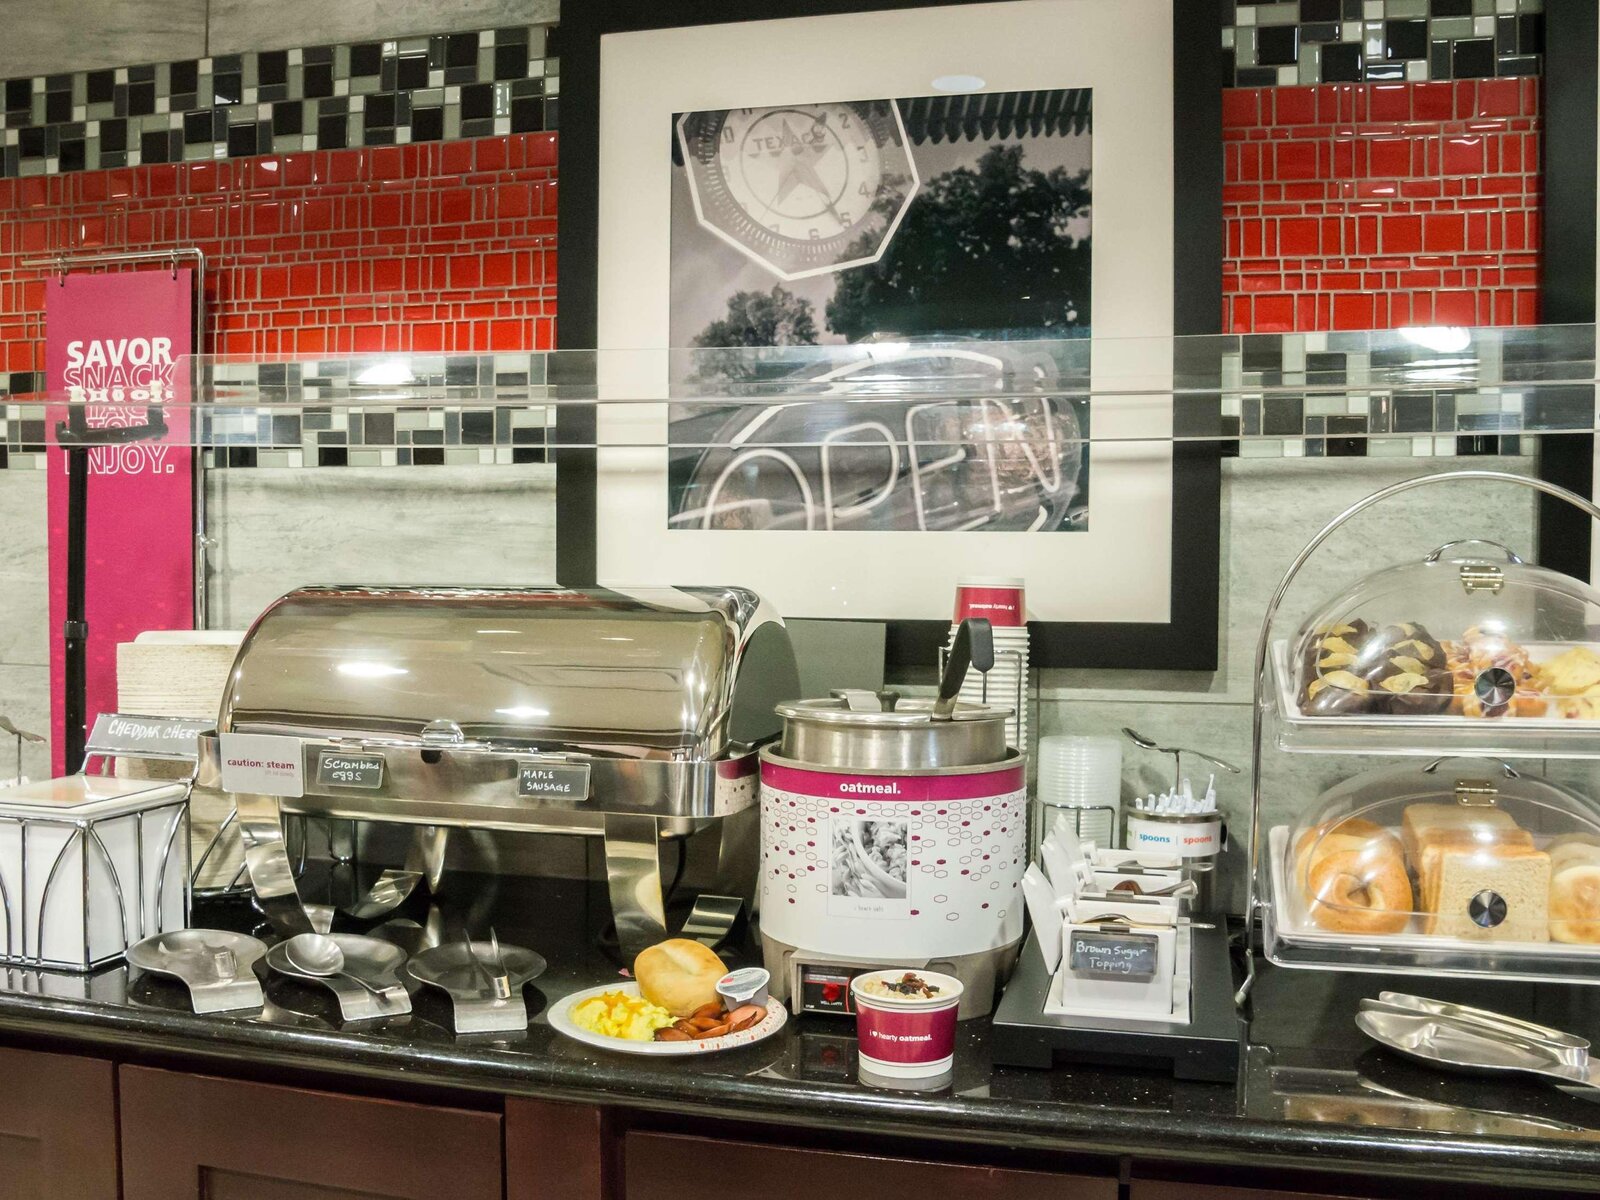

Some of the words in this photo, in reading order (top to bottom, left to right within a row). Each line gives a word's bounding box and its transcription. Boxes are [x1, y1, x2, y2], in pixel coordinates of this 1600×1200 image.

[66, 336, 172, 368] SAVOR
[63, 362, 175, 390] SNACK
[107, 719, 161, 741] CHEDDAR
[227, 758, 265, 768] caution:
[266, 759, 295, 770] steam
[332, 770, 362, 782] eggs
[523, 769, 554, 780] MAPLE
[526, 781, 571, 793] SAUSAGE
[839, 781, 901, 795] oatmeal.
[1138, 832, 1171, 844] spoons
[1183, 835, 1213, 845] spoons
[1076, 941, 1112, 954] Brown
[1113, 945, 1148, 960] Sugar
[1089, 956, 1133, 974] Topping
[878, 1031, 898, 1042] hearty
[898, 1034, 933, 1043] oatmeal.
